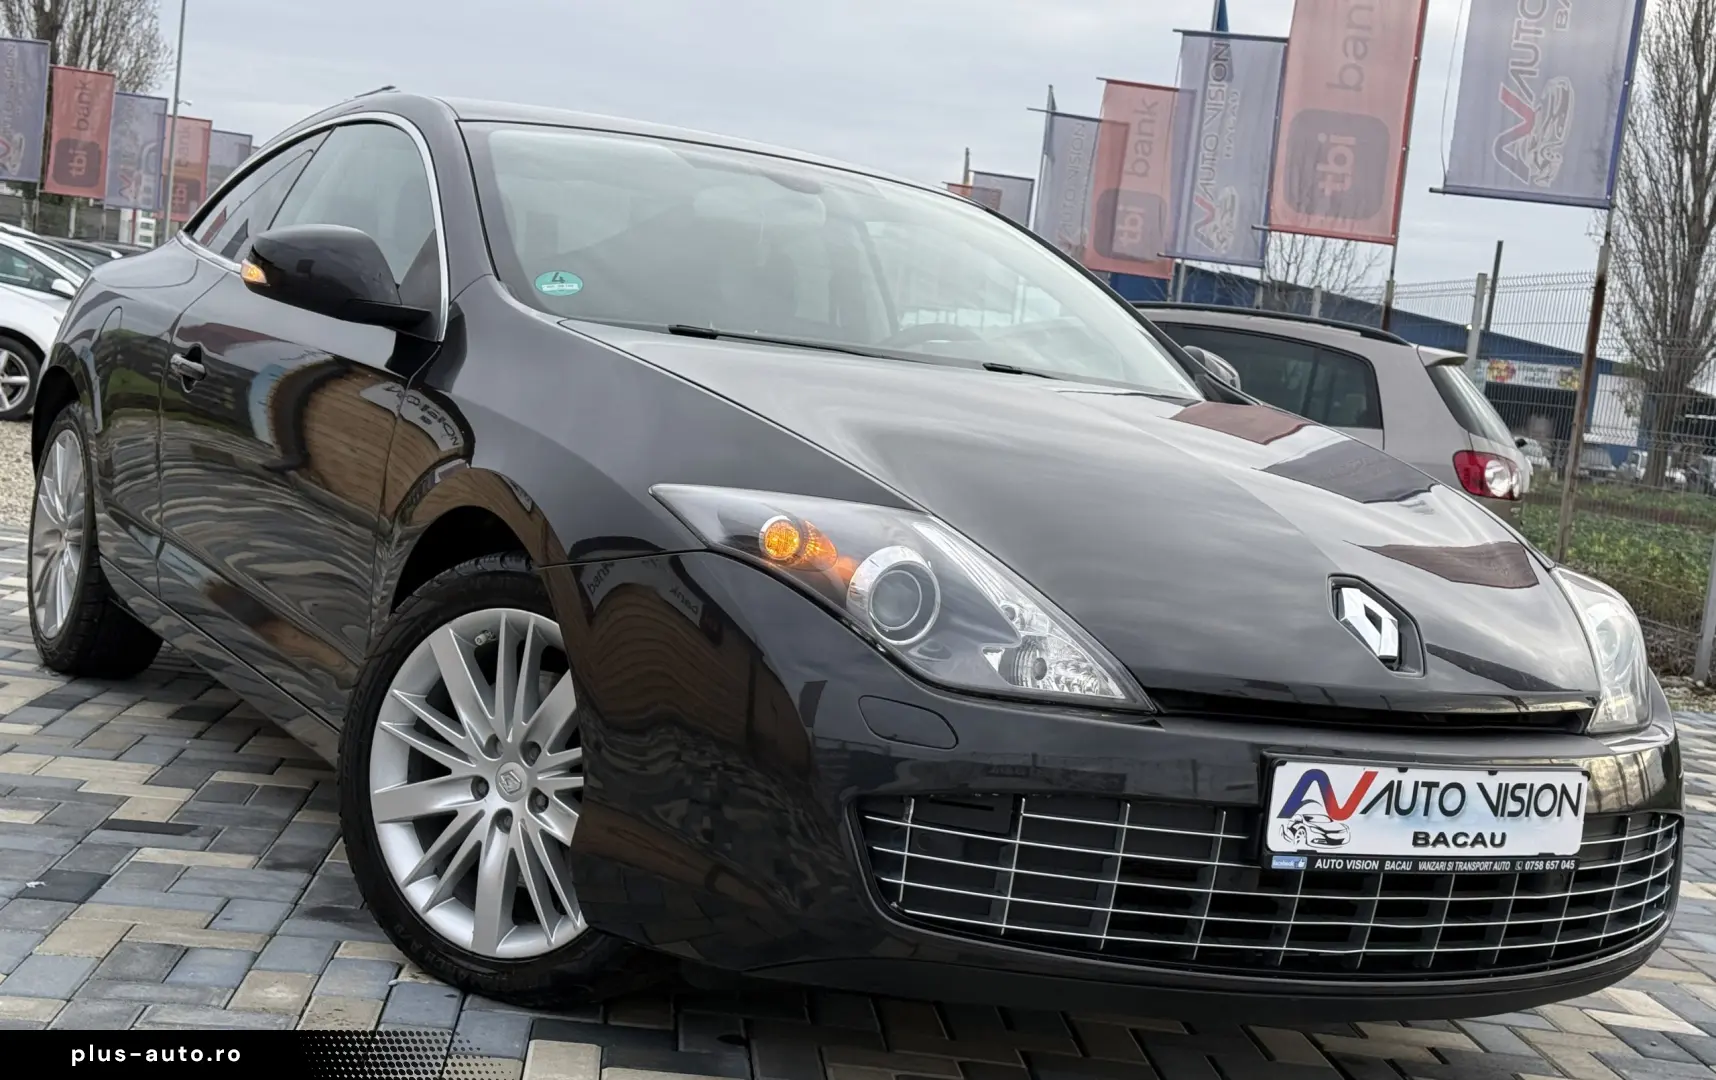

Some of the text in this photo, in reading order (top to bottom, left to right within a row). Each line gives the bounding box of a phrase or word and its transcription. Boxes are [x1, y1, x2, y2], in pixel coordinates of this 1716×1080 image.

[1203, 42, 1230, 131] VISION
[1316, 2, 1375, 197] tbi ban
[68, 77, 93, 178] tbi bank
[1117, 97, 1159, 248] tbi bank
[1198, 133, 1219, 200] AUTO
[551, 271, 566, 284] 4
[1359, 779, 1467, 817] AUTO
[1476, 782, 1583, 818] VISION
[1315, 858, 1344, 869] AUTO
[1346, 859, 1379, 870] VISION
[1384, 860, 1413, 870] BACAU
[1418, 861, 1447, 871] VANZARI
[1454, 861, 1493, 871] TRANSPORT
[1492, 861, 1511, 871] AUTO
[1525, 860, 1544, 870] 0758
[1545, 860, 1560, 870] 657
[1560, 860, 1576, 869] 045
[1412, 831, 1507, 849] BACAU
